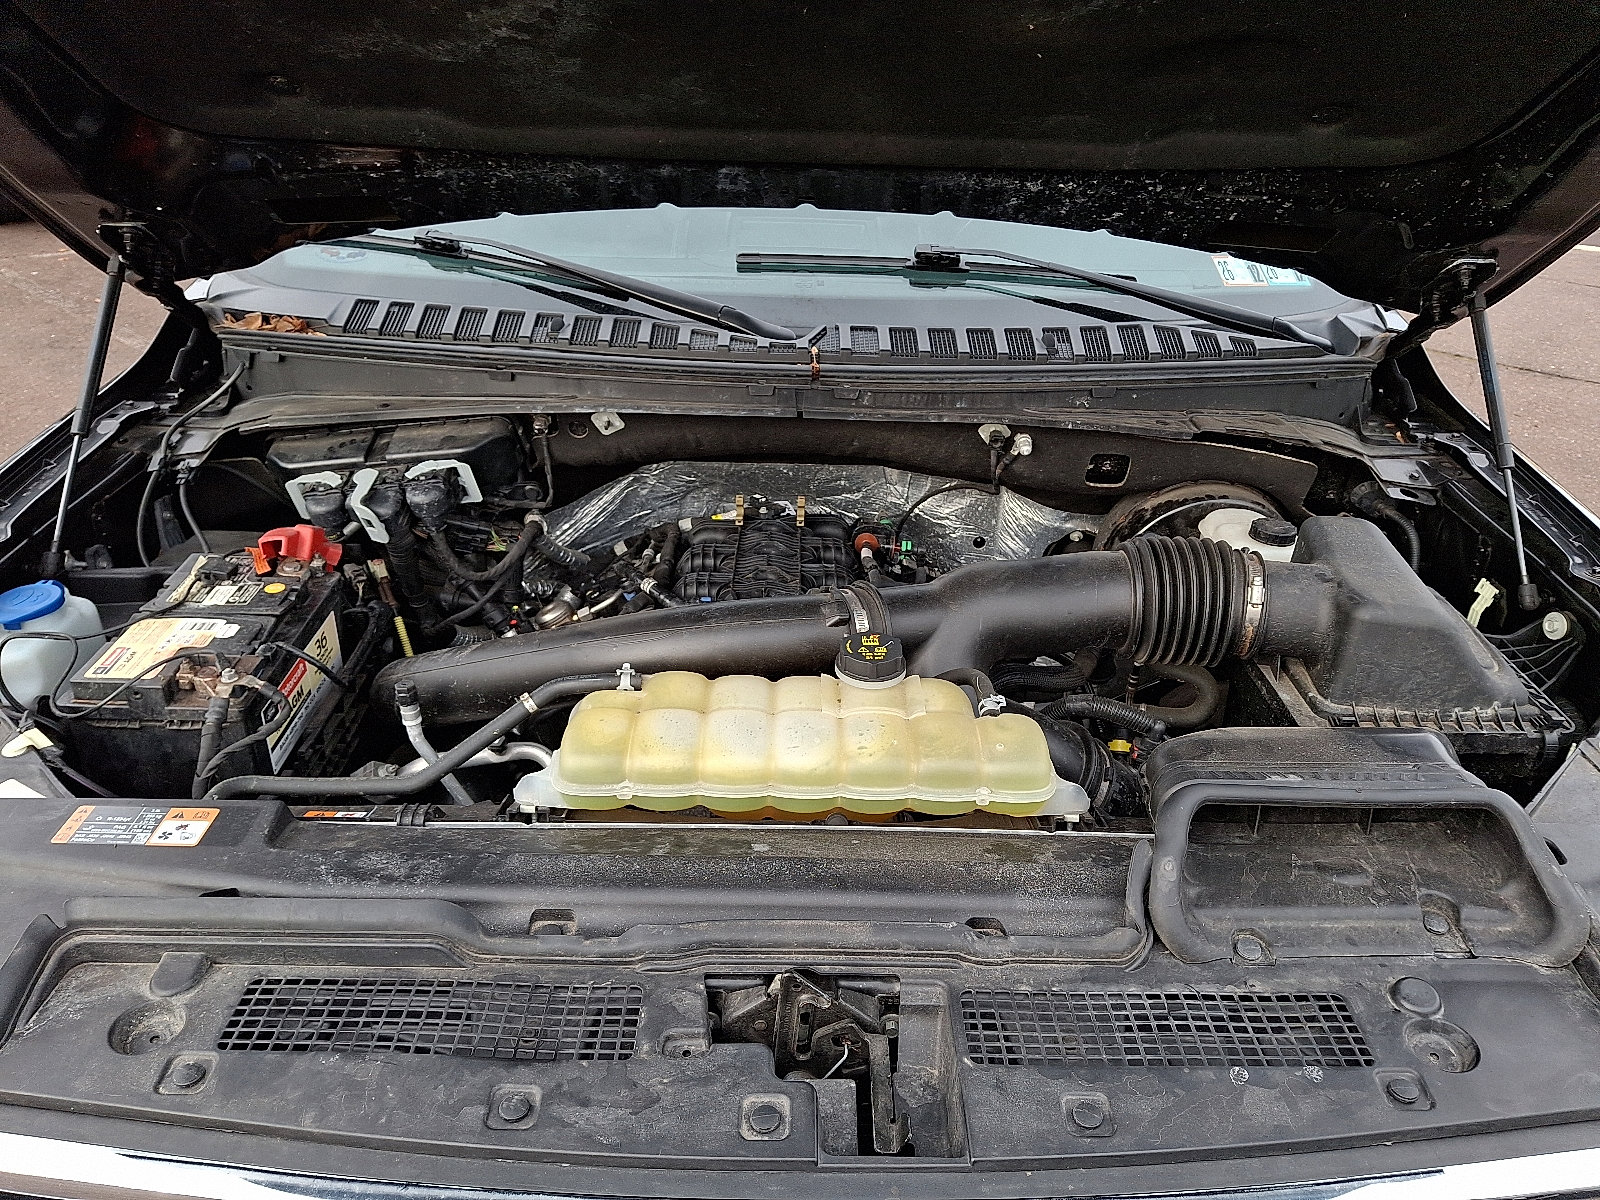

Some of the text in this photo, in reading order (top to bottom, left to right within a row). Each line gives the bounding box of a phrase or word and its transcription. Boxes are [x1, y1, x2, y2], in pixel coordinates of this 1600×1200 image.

[1217, 260, 1264, 283] 26 12
[314, 630, 328, 657] 36
[282, 662, 306, 696] otorcraft
[291, 684, 305, 708] GM
